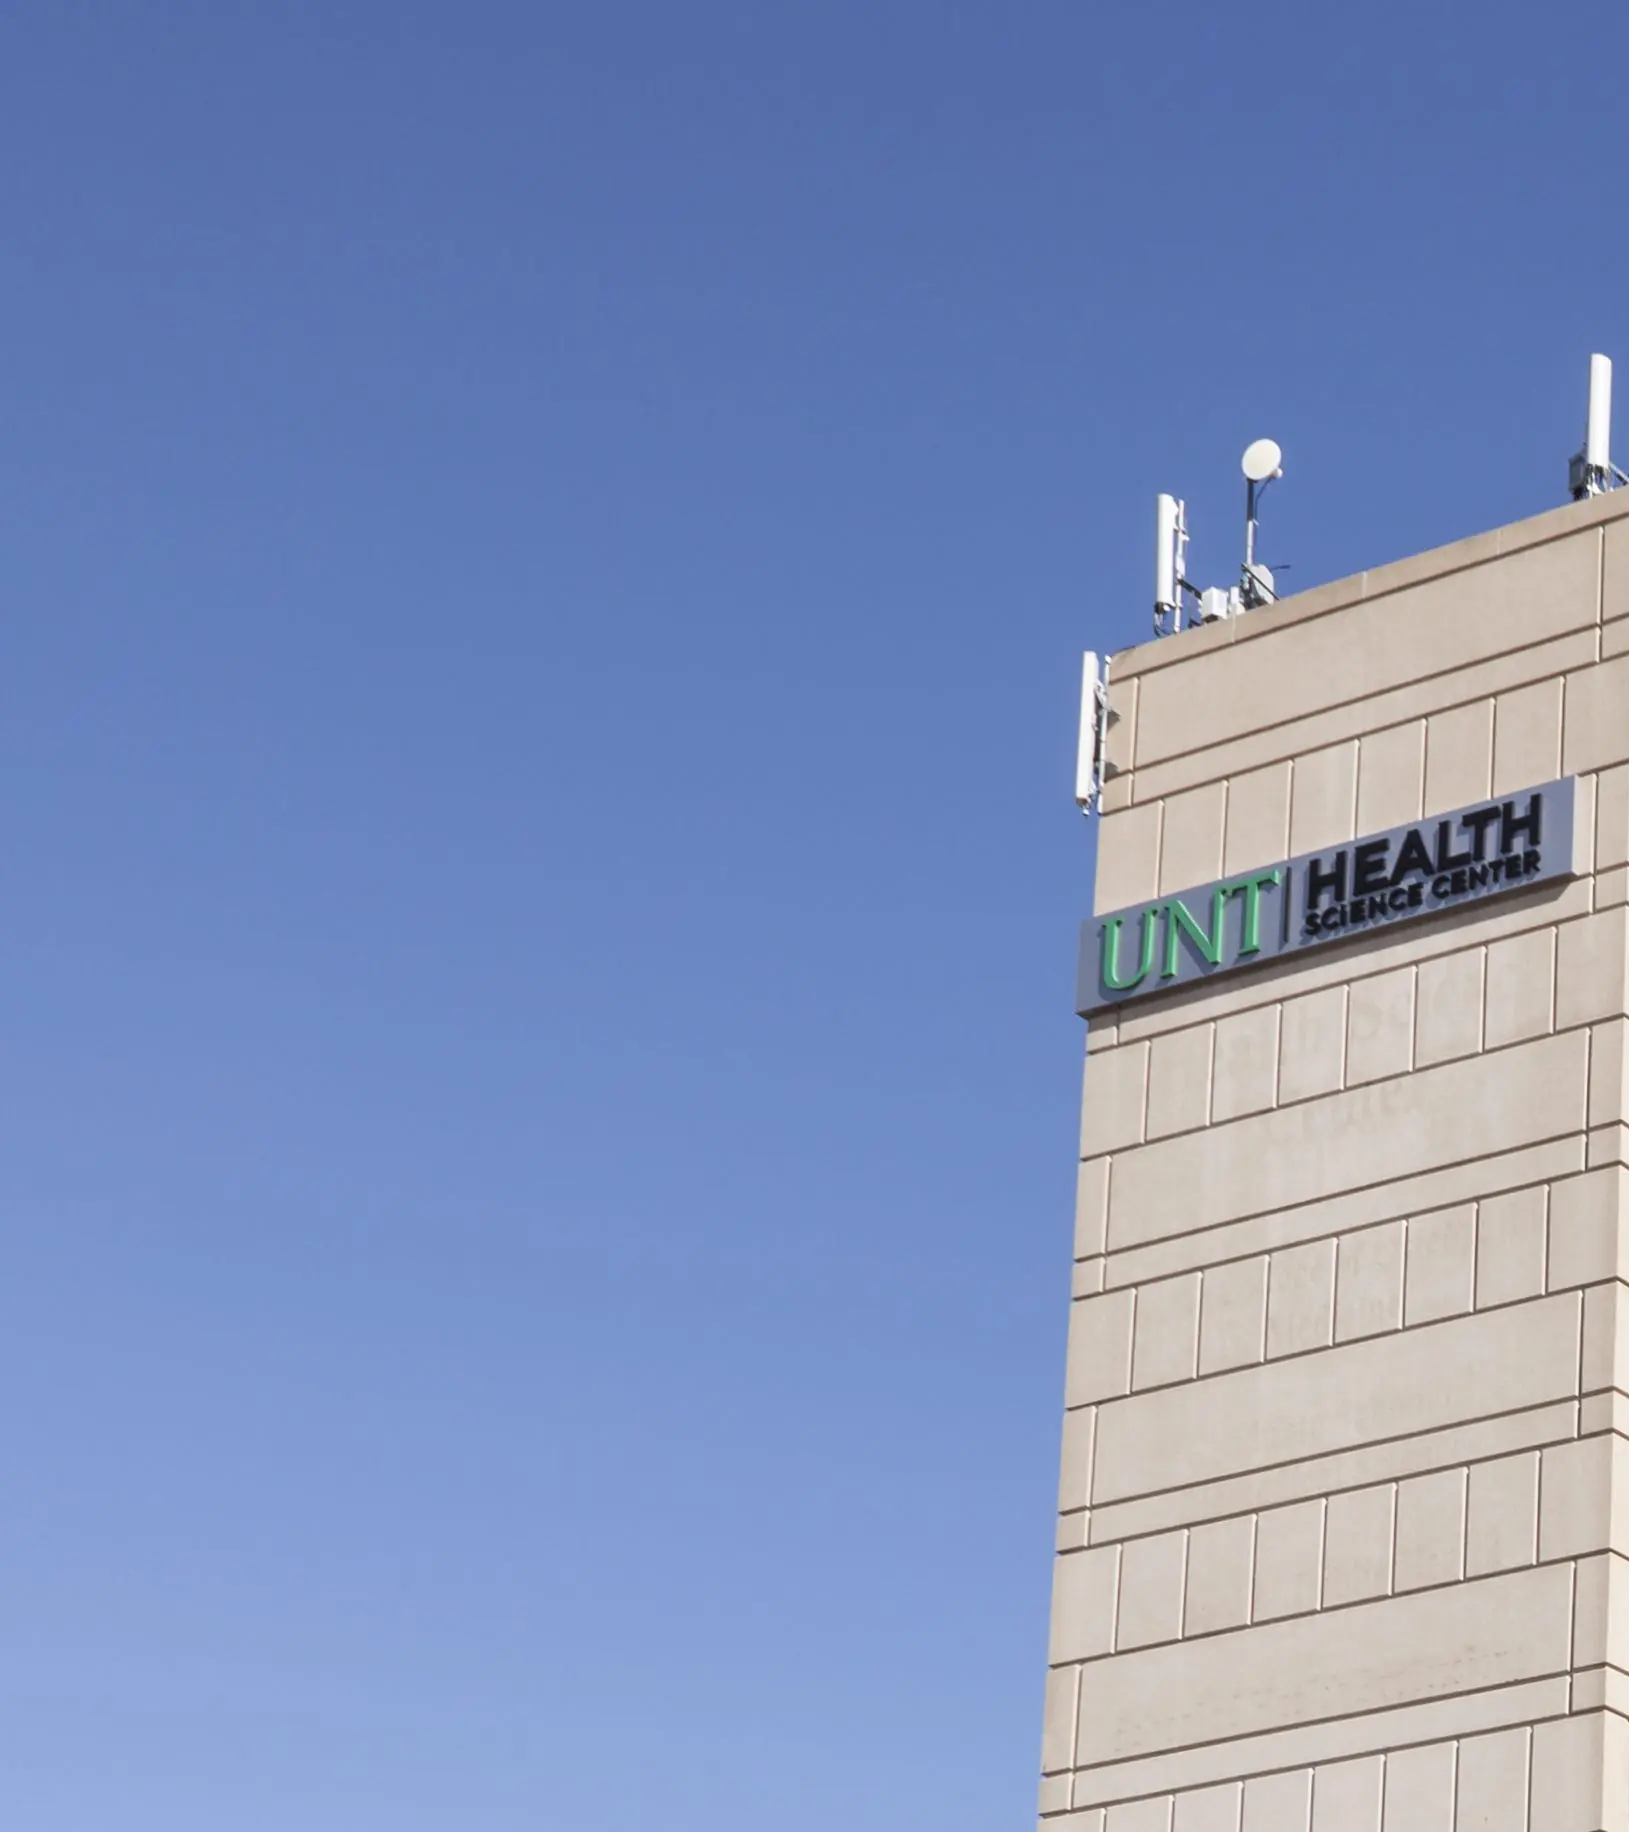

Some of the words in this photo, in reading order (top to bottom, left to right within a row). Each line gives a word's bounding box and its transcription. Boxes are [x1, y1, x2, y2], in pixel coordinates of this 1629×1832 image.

[1304, 883, 1424, 936] SCIENCE
[1431, 849, 1541, 899] CENTER
[1307, 793, 1542, 910] HEALTH
[1101, 870, 1280, 990] UNT
